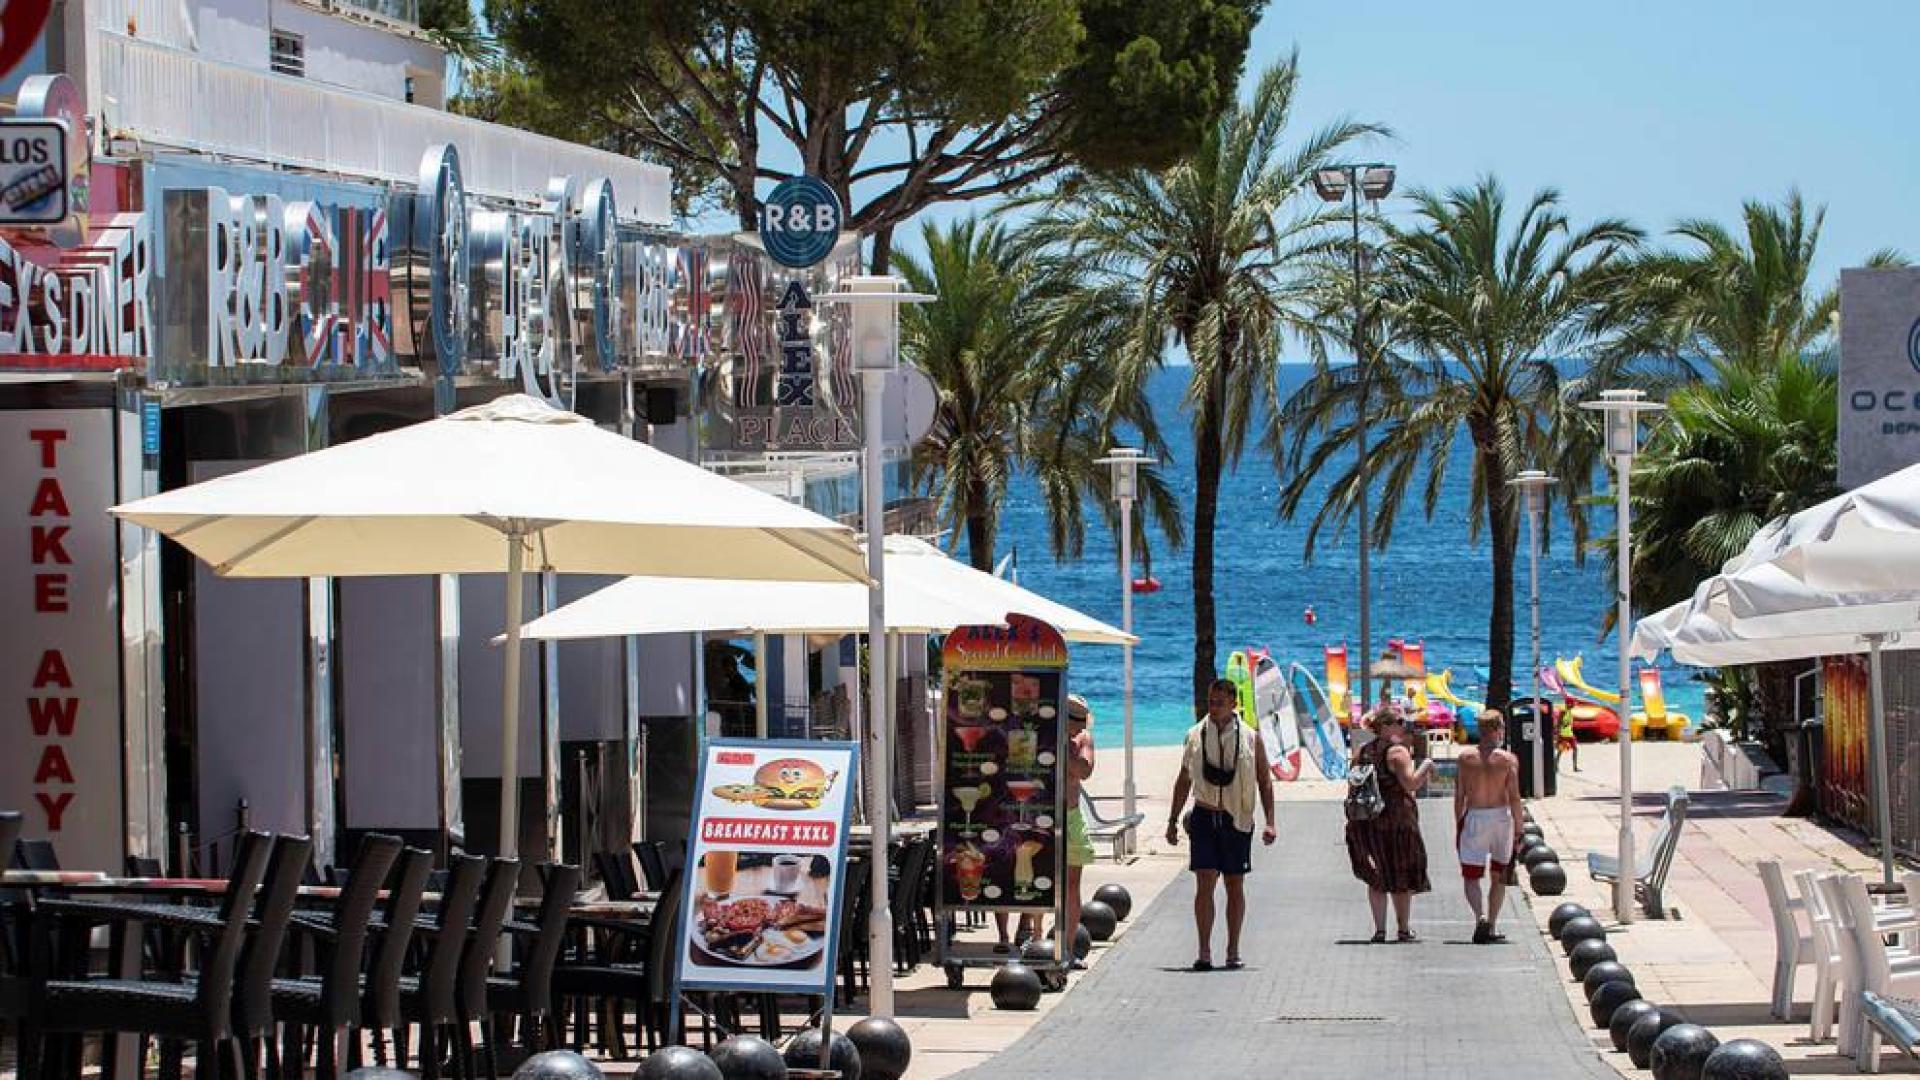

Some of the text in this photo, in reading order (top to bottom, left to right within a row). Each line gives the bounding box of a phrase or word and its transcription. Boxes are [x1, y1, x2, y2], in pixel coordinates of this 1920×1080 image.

[766, 204, 836, 232] R&B
[70, 212, 151, 358] DINER
[776, 281, 814, 406] ALEX
[739, 416, 856, 445] PLACE
[27, 430, 79, 832] TAKE AWAY
[704, 823, 829, 841] BREAKFAST XXXL
